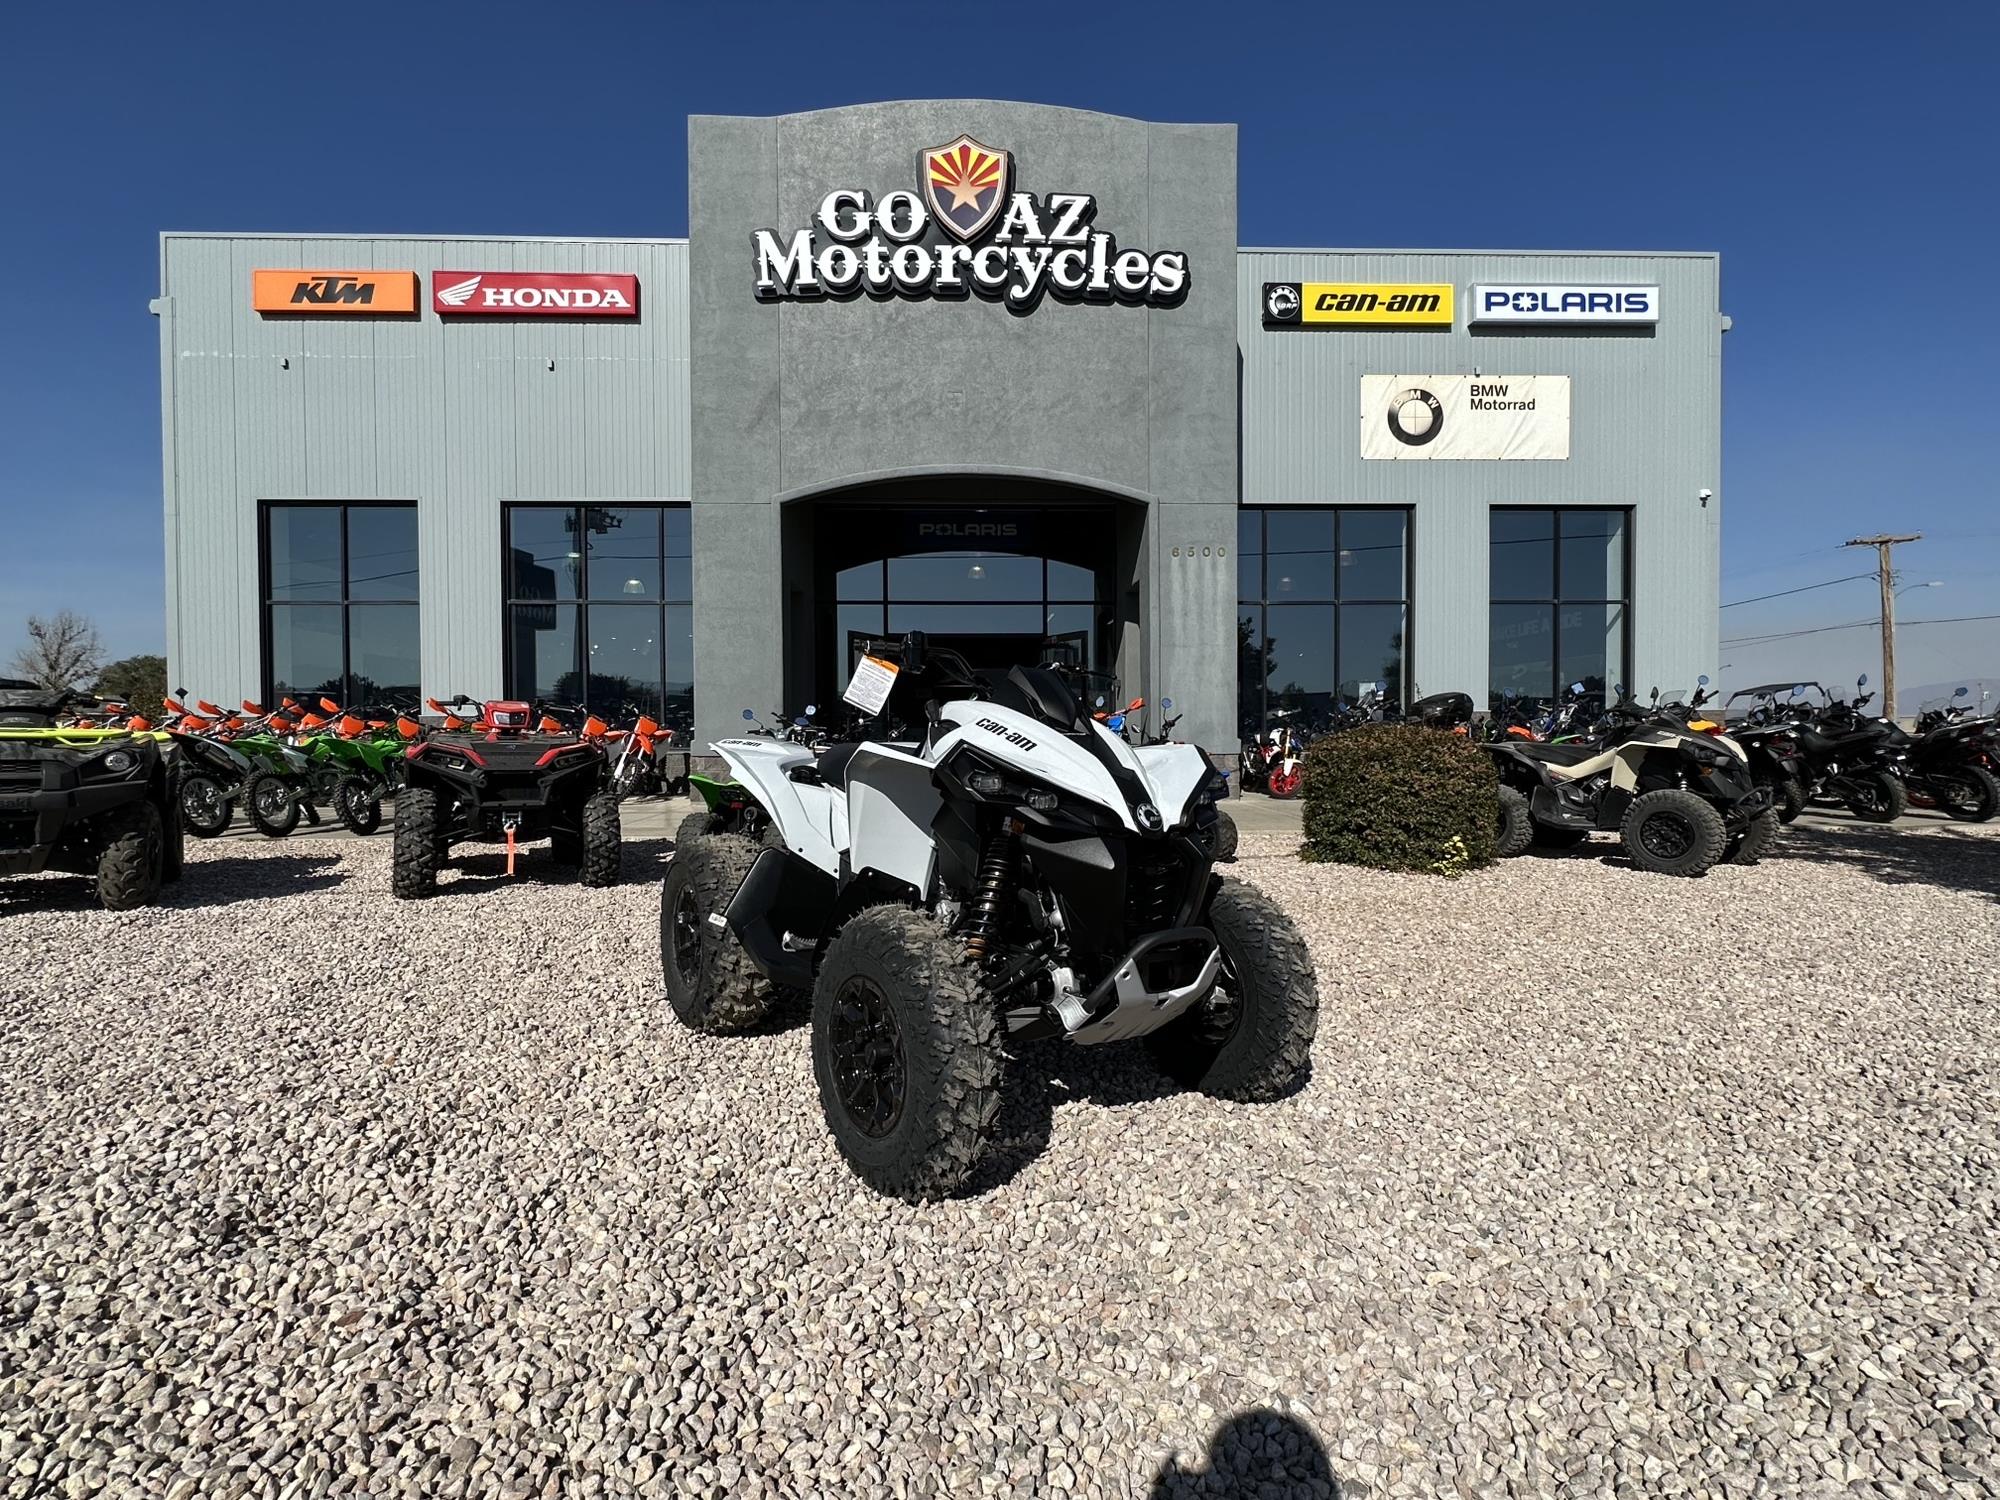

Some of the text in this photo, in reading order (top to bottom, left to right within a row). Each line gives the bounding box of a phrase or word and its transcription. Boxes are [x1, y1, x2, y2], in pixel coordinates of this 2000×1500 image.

[818, 190, 1092, 245] GO AZ
[756, 230, 1187, 301] Motorcycles
[290, 276, 376, 304] KTM
[482, 287, 631, 308] HONDA
[1314, 293, 1441, 312] can-am
[1485, 292, 1649, 313] POLARIS
[1470, 384, 1509, 397] BMW
[1470, 398, 1536, 411] Motorrad
[919, 523, 1018, 537] POLARIS
[1171, 546, 1227, 558] 6500
[975, 717, 1038, 752] can-am
